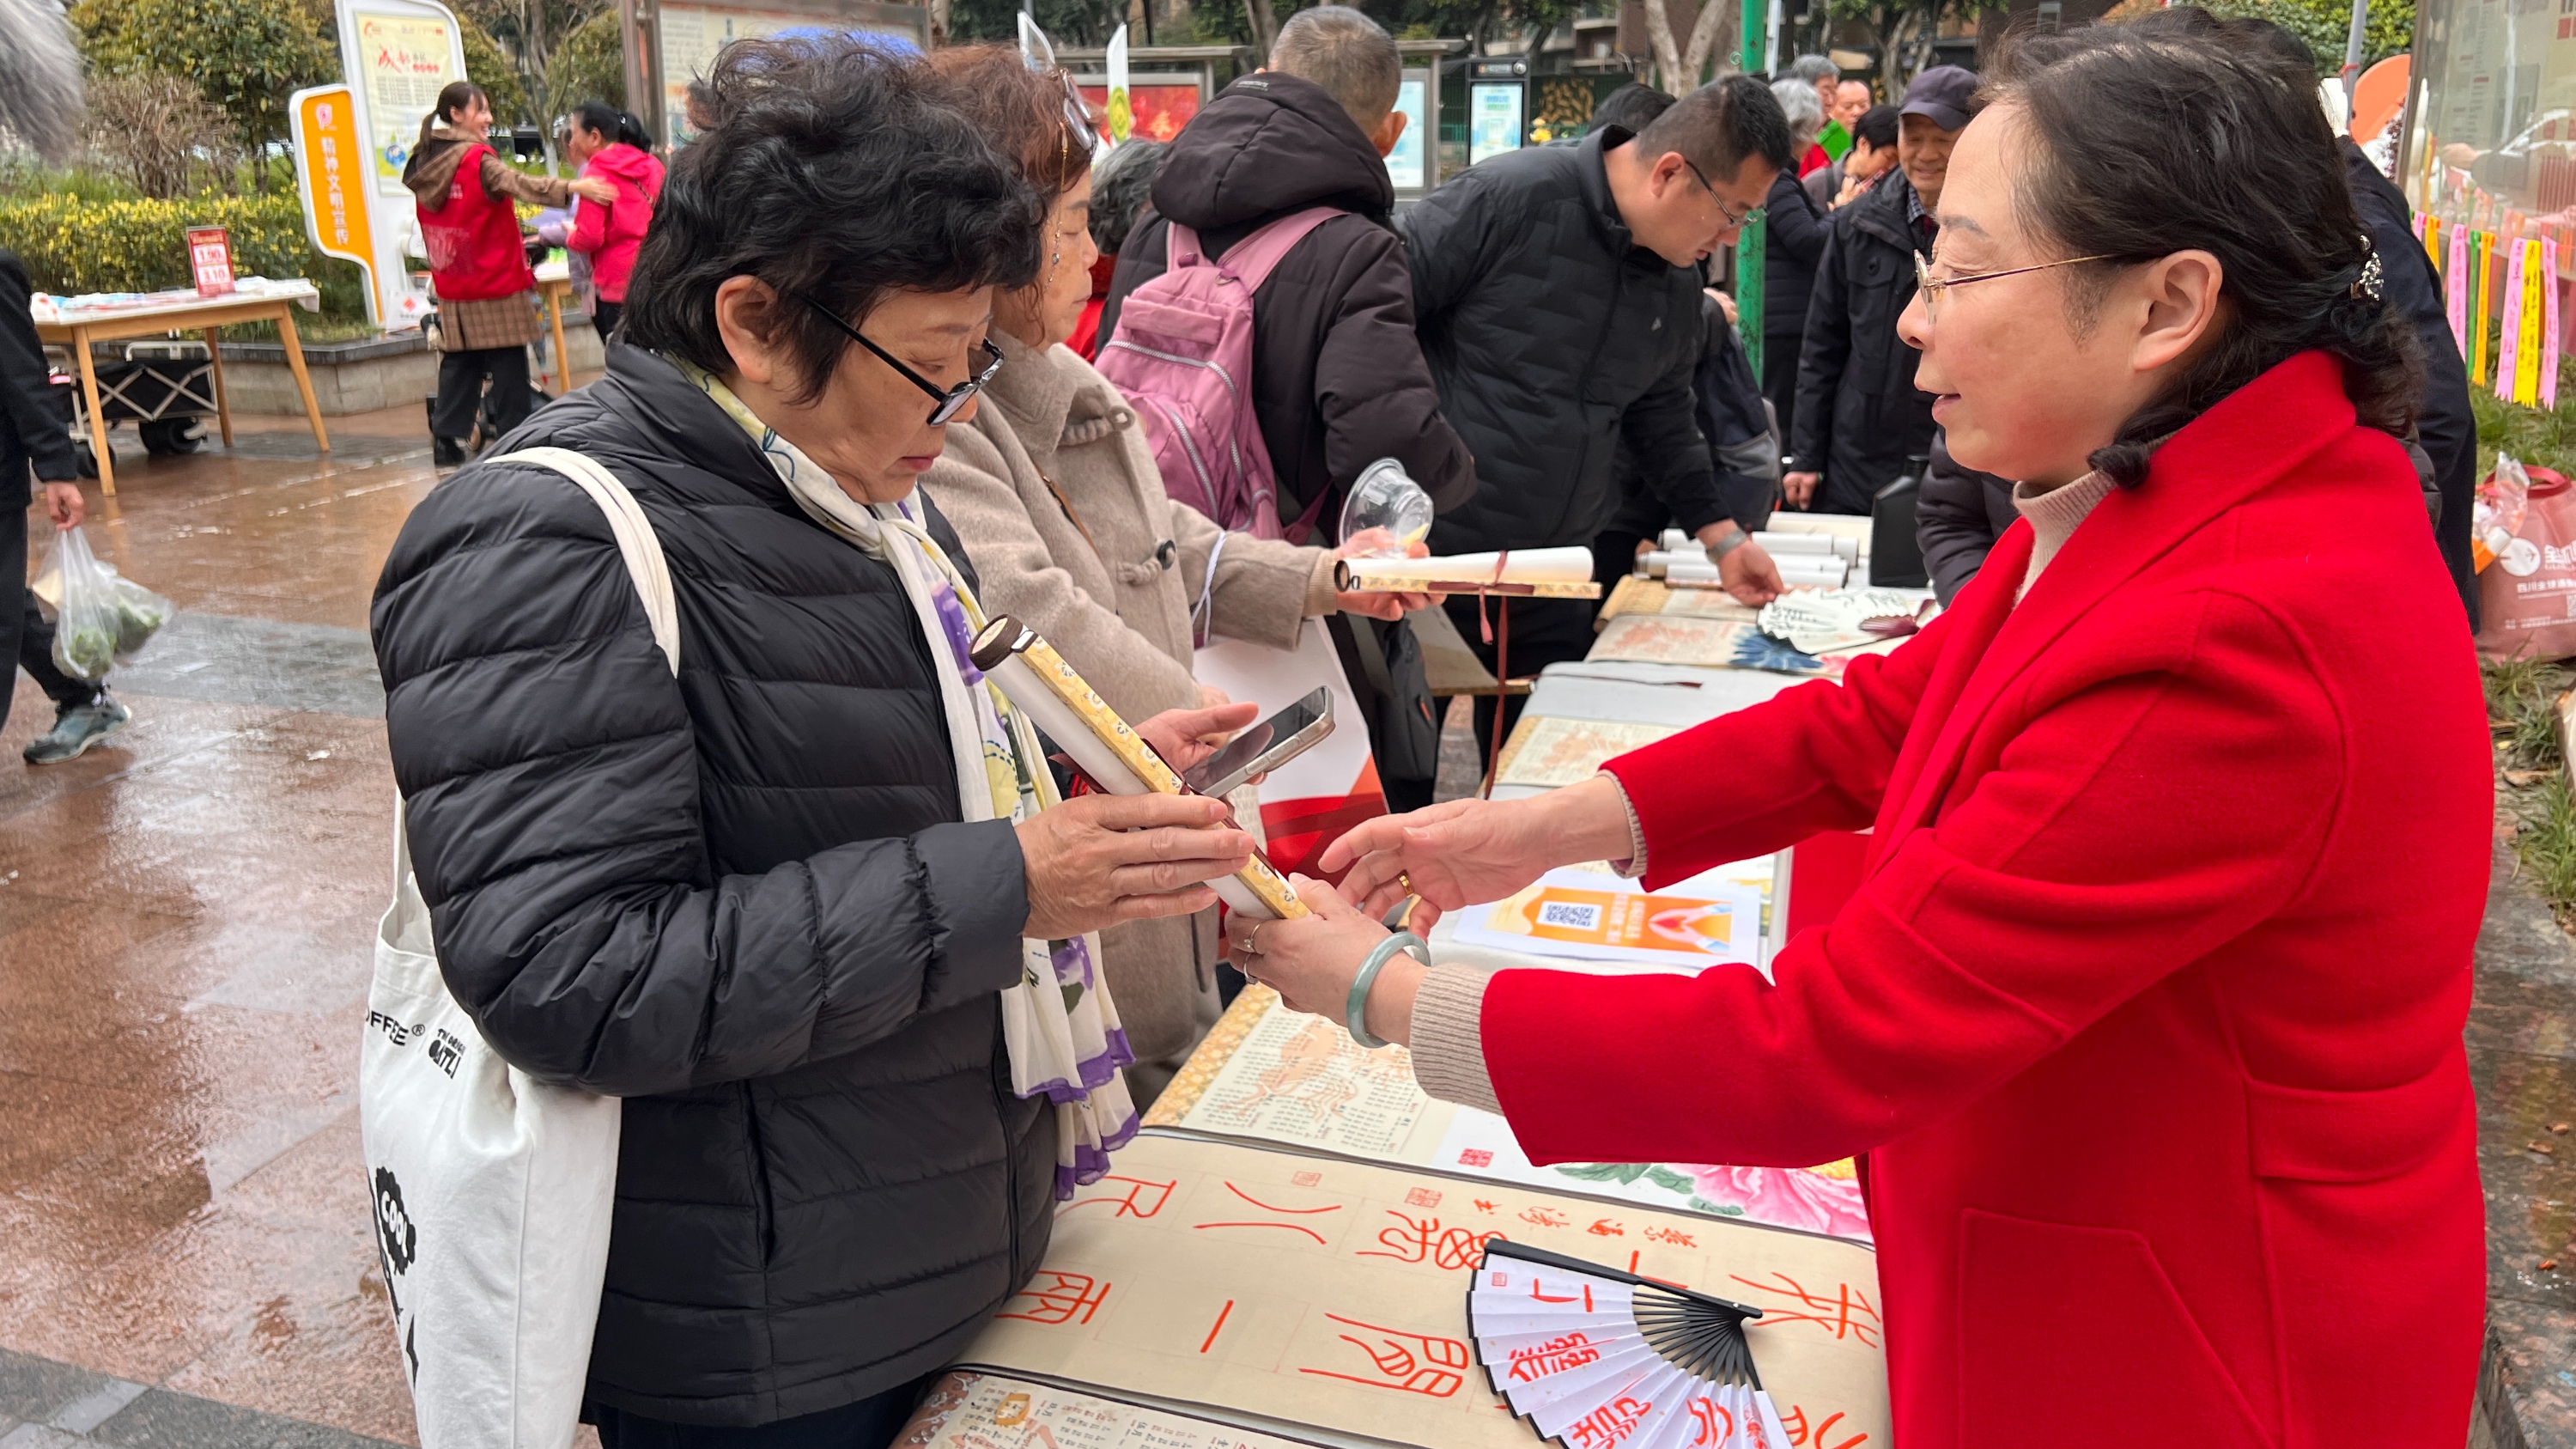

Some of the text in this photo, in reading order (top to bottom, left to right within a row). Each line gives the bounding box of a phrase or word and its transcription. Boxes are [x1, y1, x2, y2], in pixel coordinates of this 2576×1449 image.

[320, 136, 349, 247] 精神文明宣传
[380, 1190, 409, 1258] COOL
